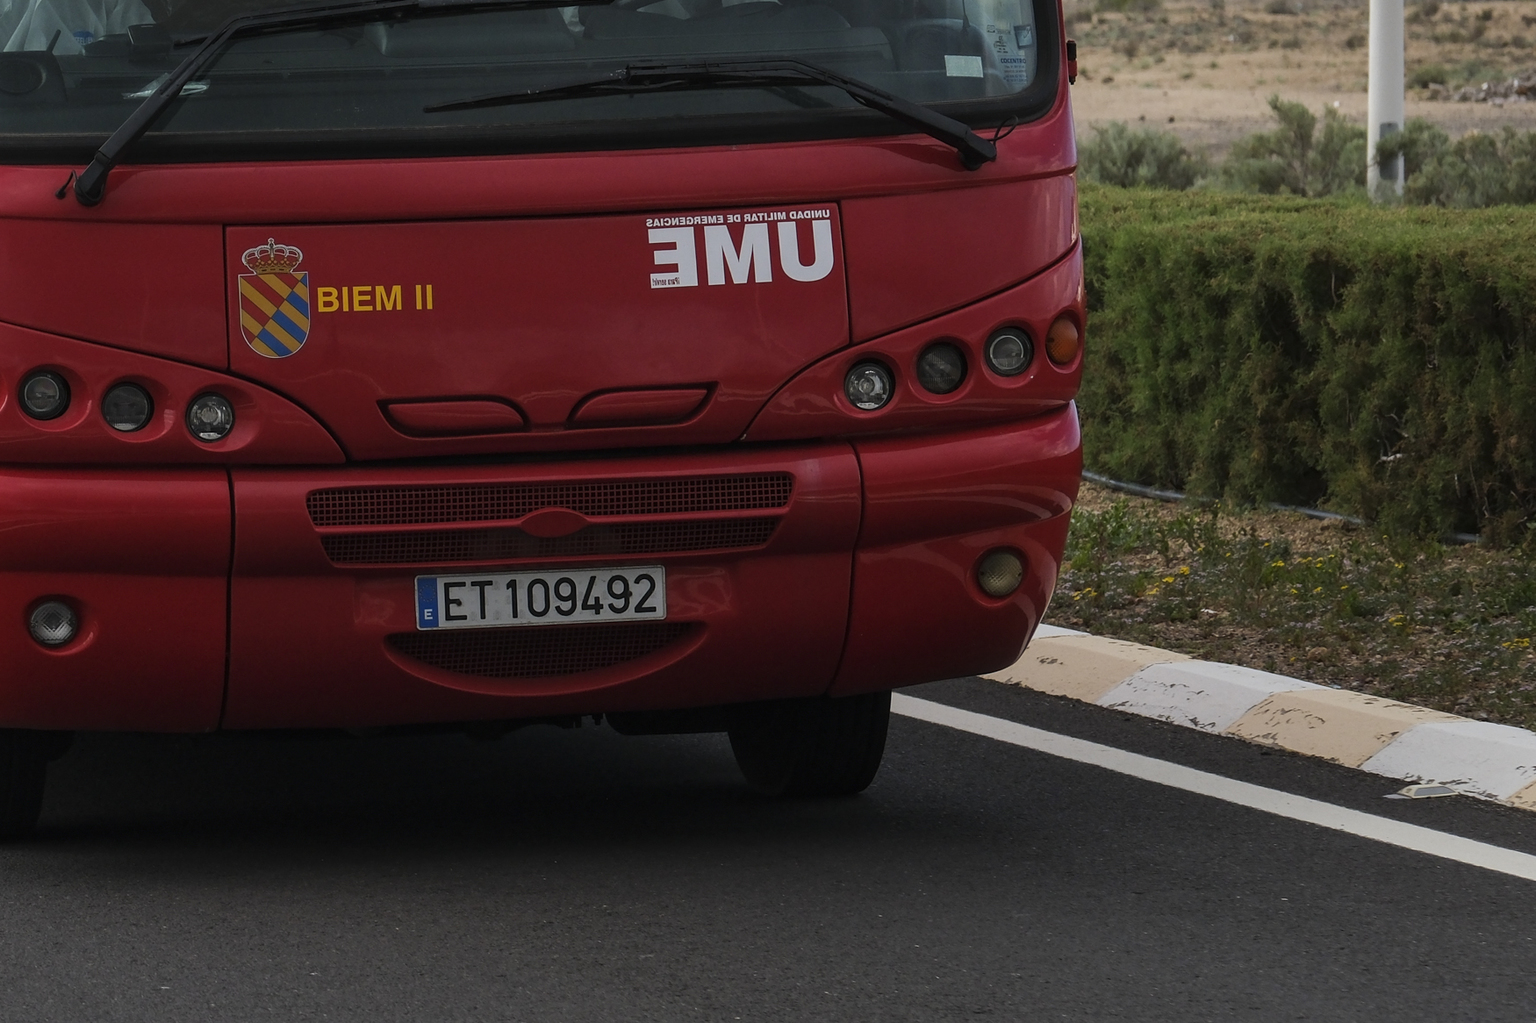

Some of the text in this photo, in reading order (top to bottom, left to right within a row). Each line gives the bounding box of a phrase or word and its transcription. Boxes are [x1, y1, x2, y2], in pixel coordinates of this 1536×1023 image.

[317, 284, 433, 313] BIEM II
[424, 608, 433, 620] E
